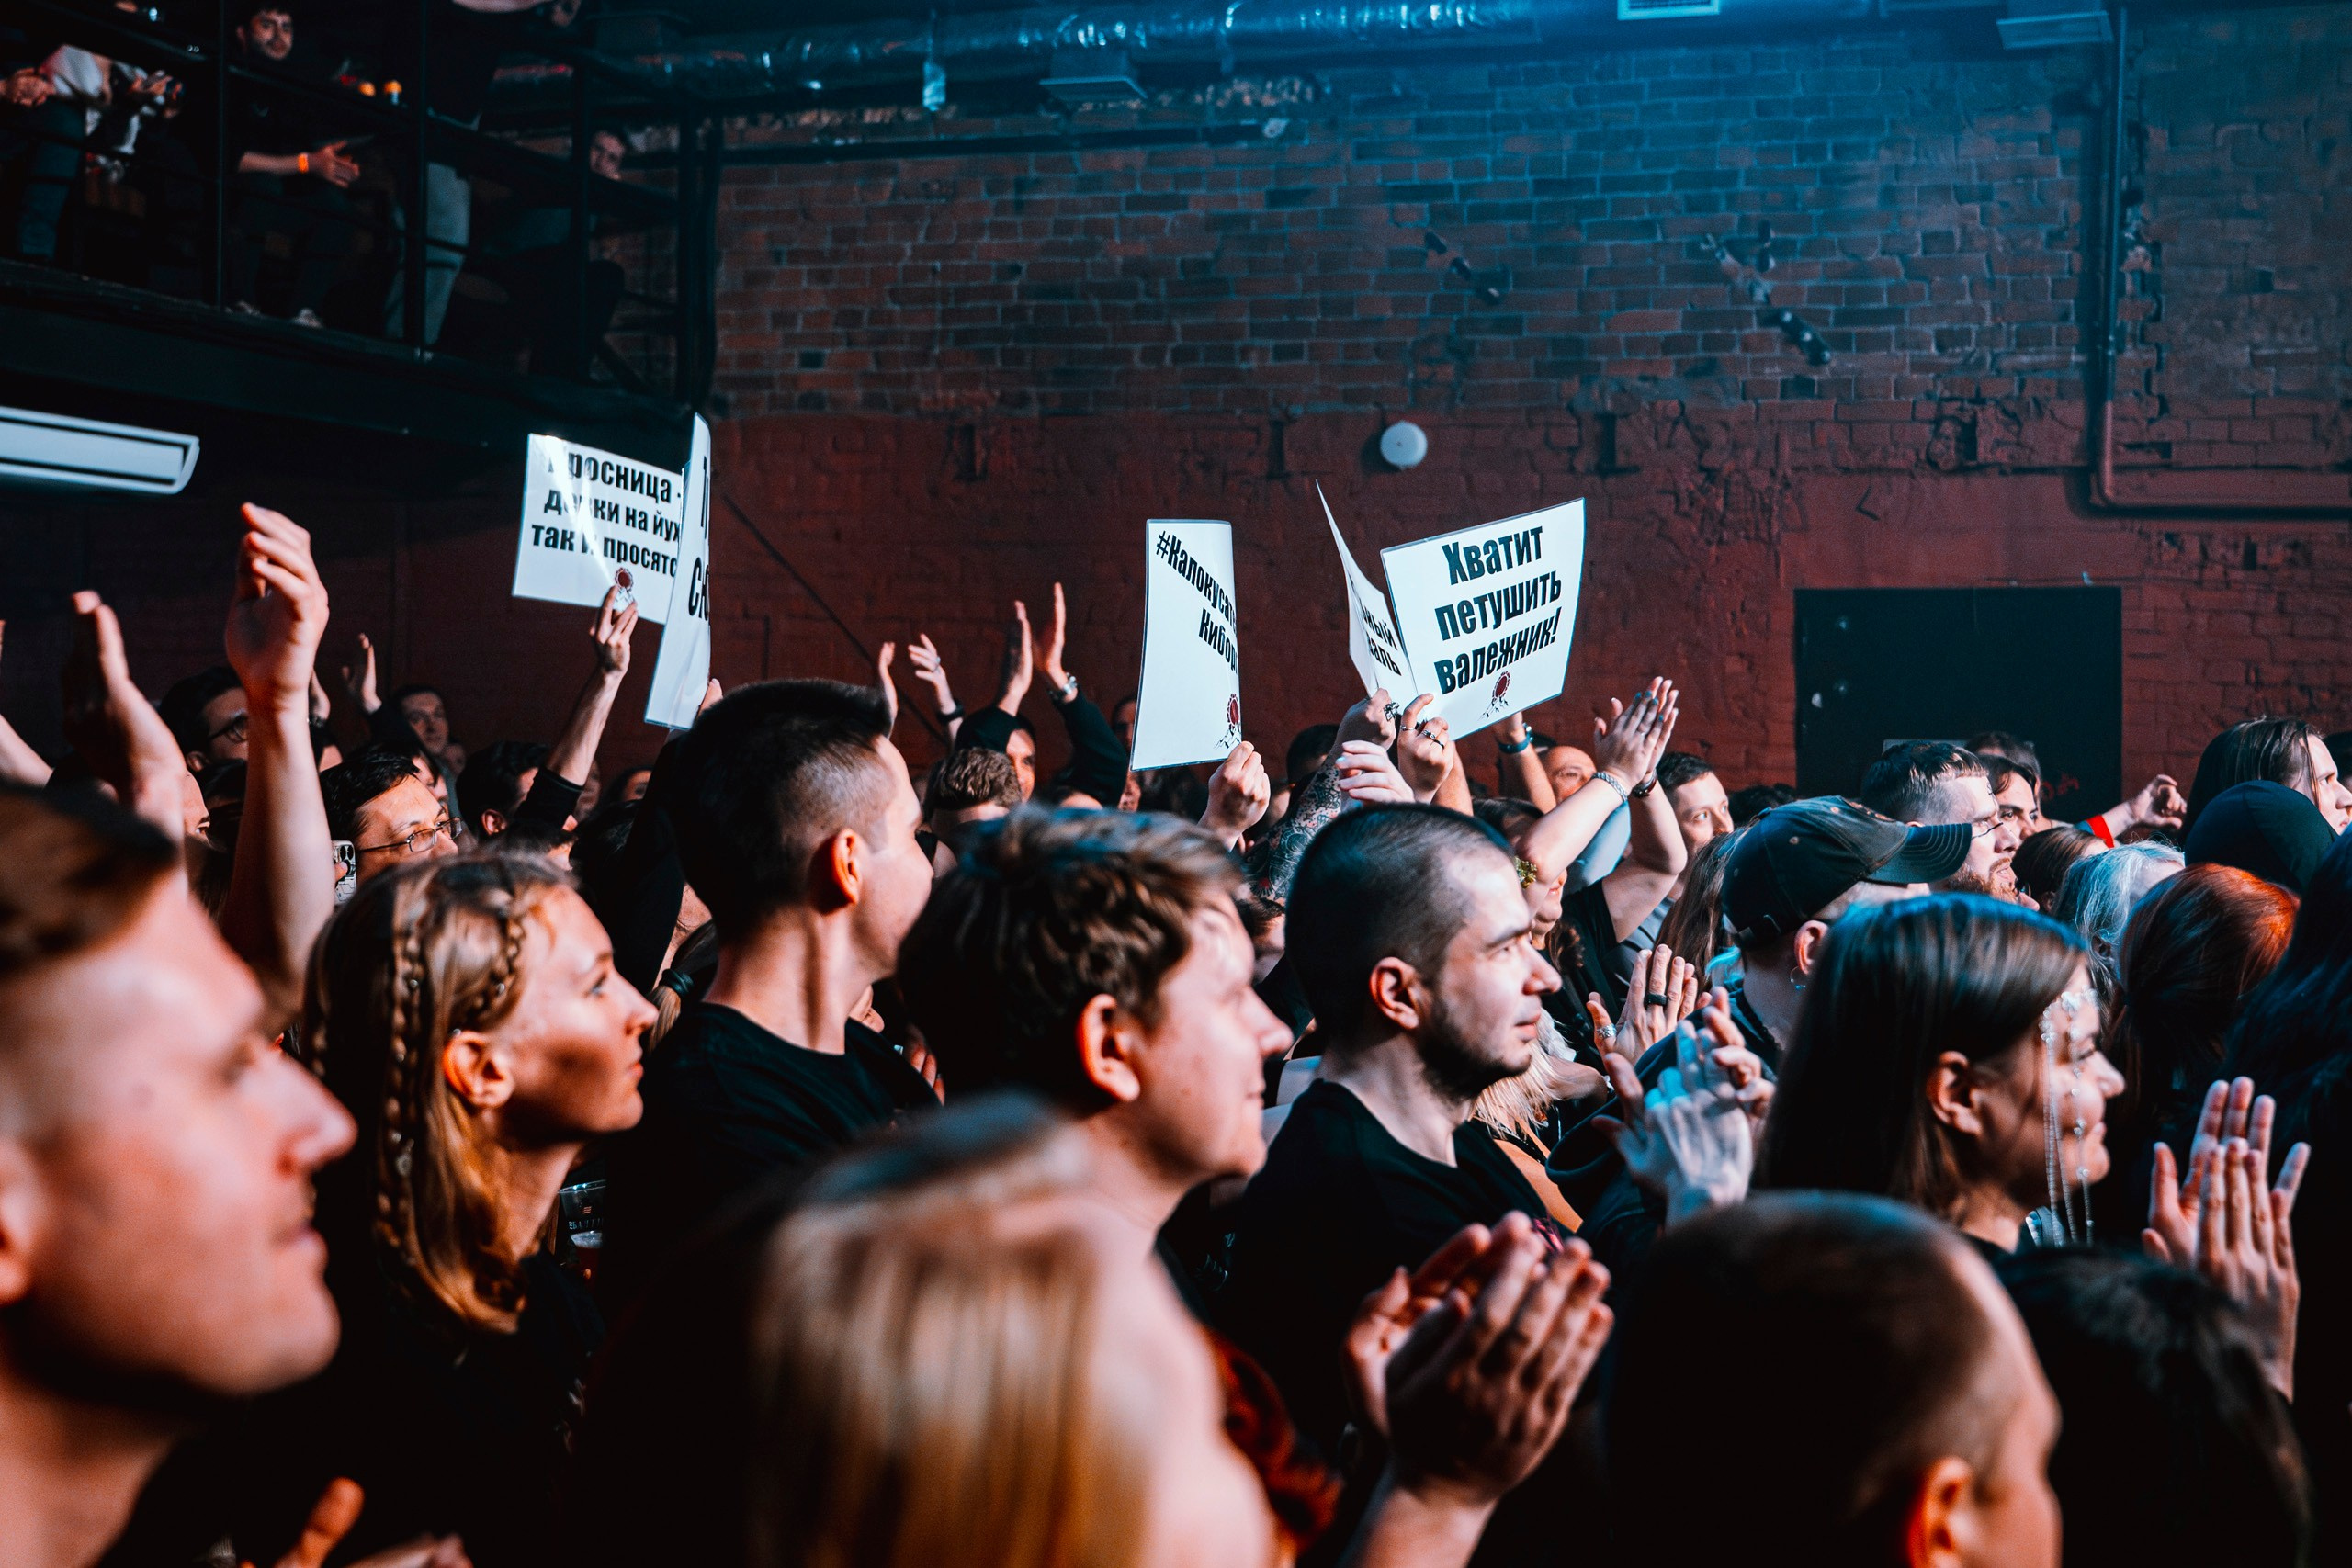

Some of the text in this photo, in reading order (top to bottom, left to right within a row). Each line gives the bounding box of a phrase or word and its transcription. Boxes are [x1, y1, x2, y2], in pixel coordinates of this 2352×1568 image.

[548, 451, 672, 504] росница
[531, 524, 575, 552] так
[543, 489, 620, 525] дки
[625, 505, 649, 533] на
[1441, 525, 1544, 586] Хватит
[1434, 570, 1562, 642] петушить
[1433, 605, 1563, 695] валежник!
